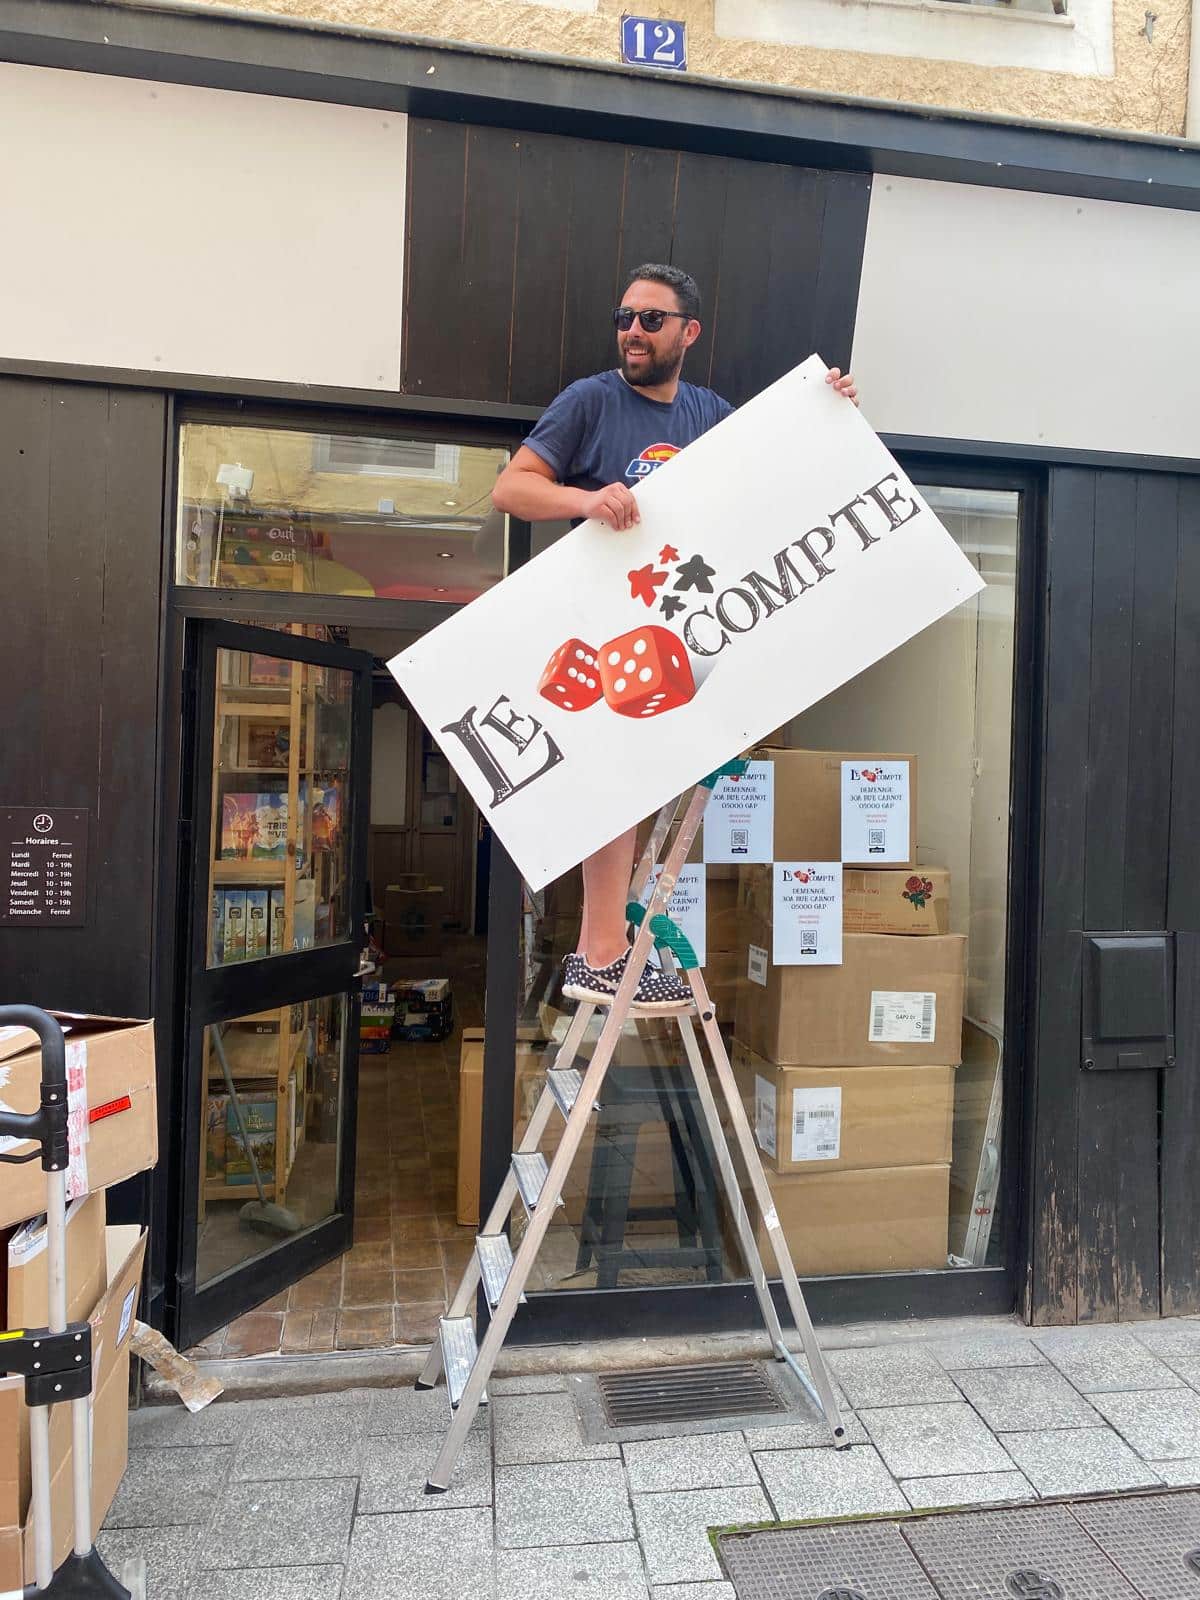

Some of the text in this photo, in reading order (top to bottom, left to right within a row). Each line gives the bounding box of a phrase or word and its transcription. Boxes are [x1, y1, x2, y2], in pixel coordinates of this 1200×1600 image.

[633, 22, 676, 62] 12
[683, 472, 921, 656] COMPTE
[25, 837, 59, 845] Horaires
